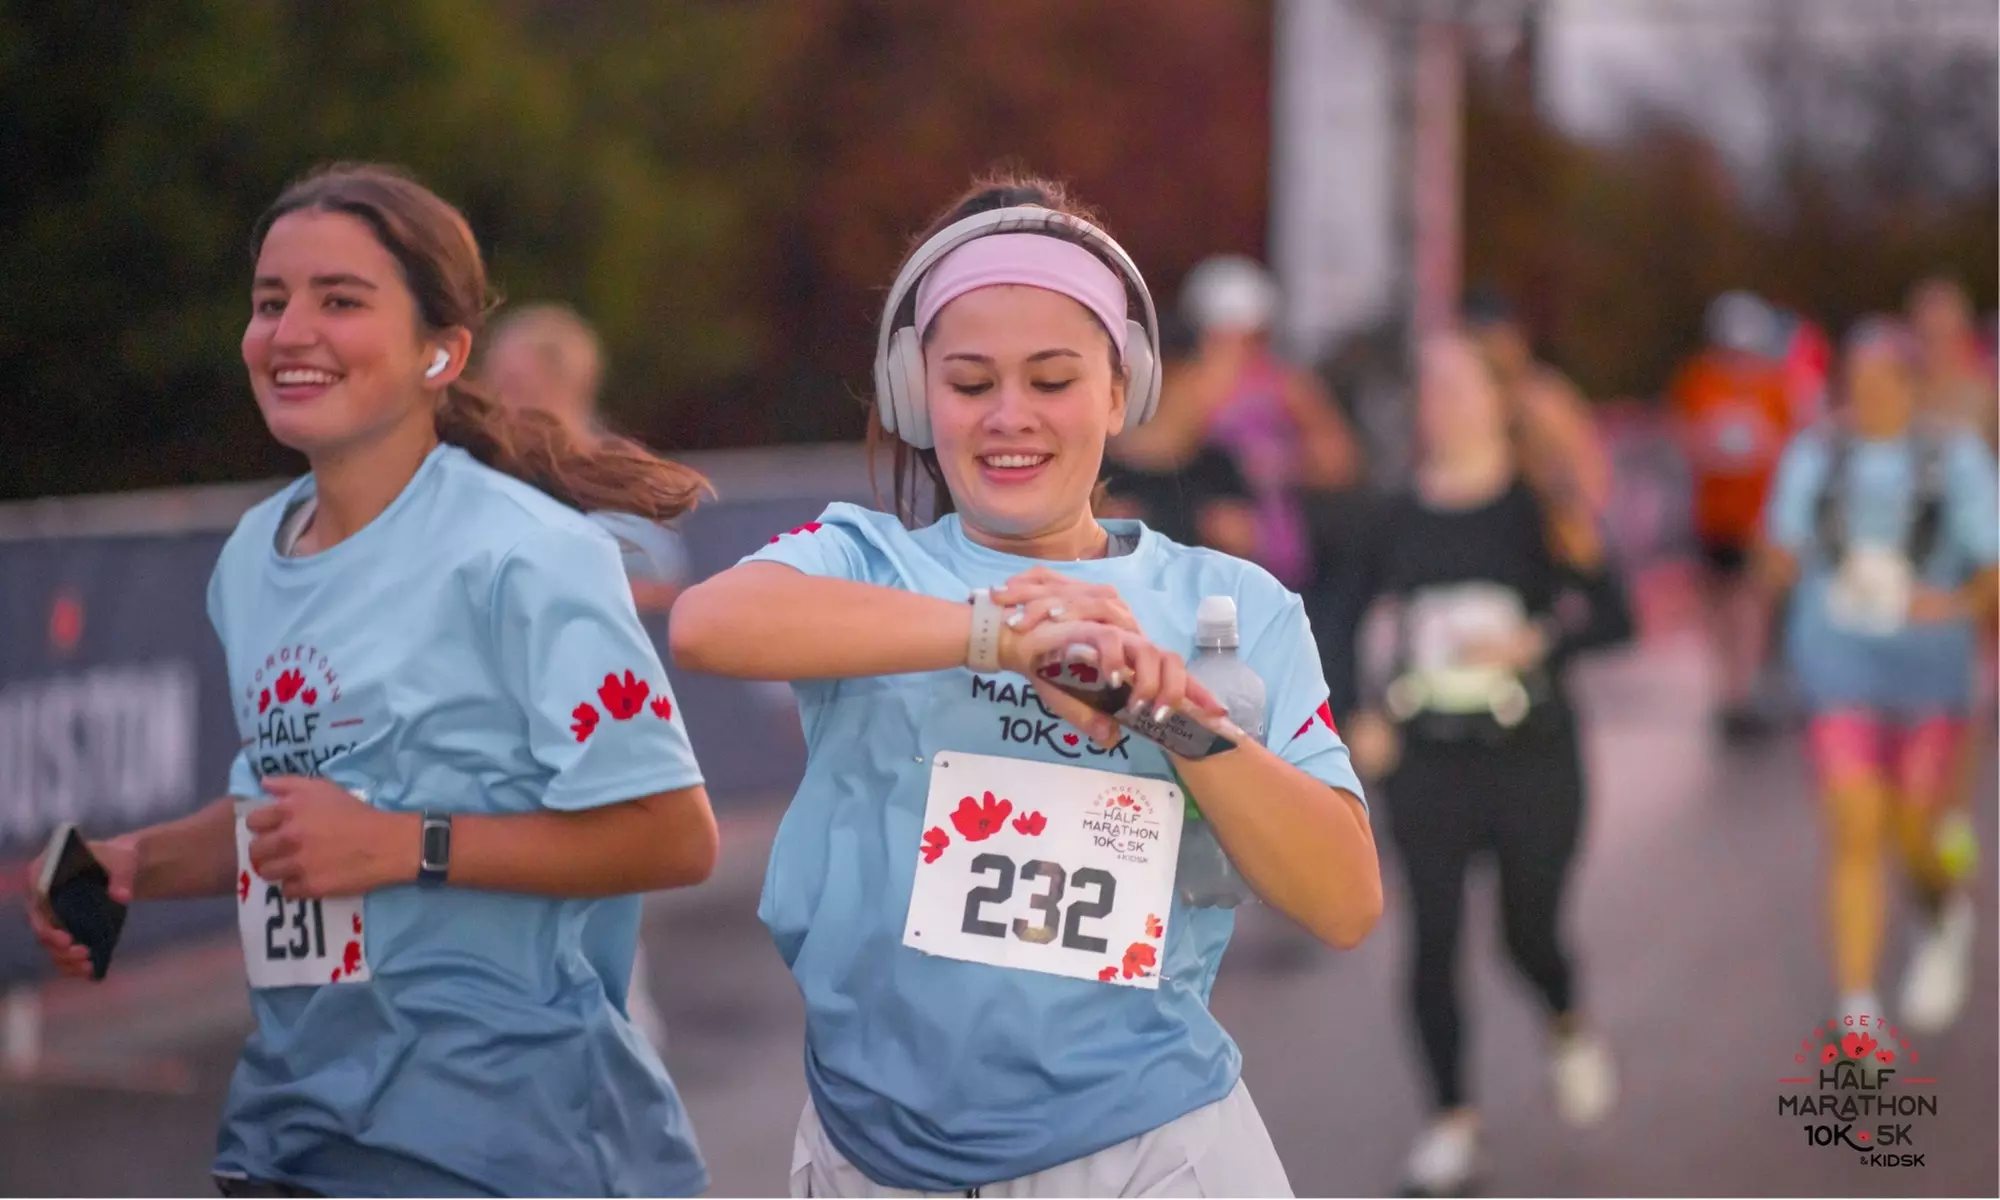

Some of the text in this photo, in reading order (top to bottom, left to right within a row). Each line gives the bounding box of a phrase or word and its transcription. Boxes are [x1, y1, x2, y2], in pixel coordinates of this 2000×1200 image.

[258, 707, 320, 749] HALF
[999, 715, 1081, 758] 10K
[1082, 819, 1159, 841] MARATHON
[1103, 806, 1141, 824] HALF
[1094, 835, 1145, 853] 10K 5K
[265, 884, 326, 961] 231
[961, 852, 1117, 954] 232
